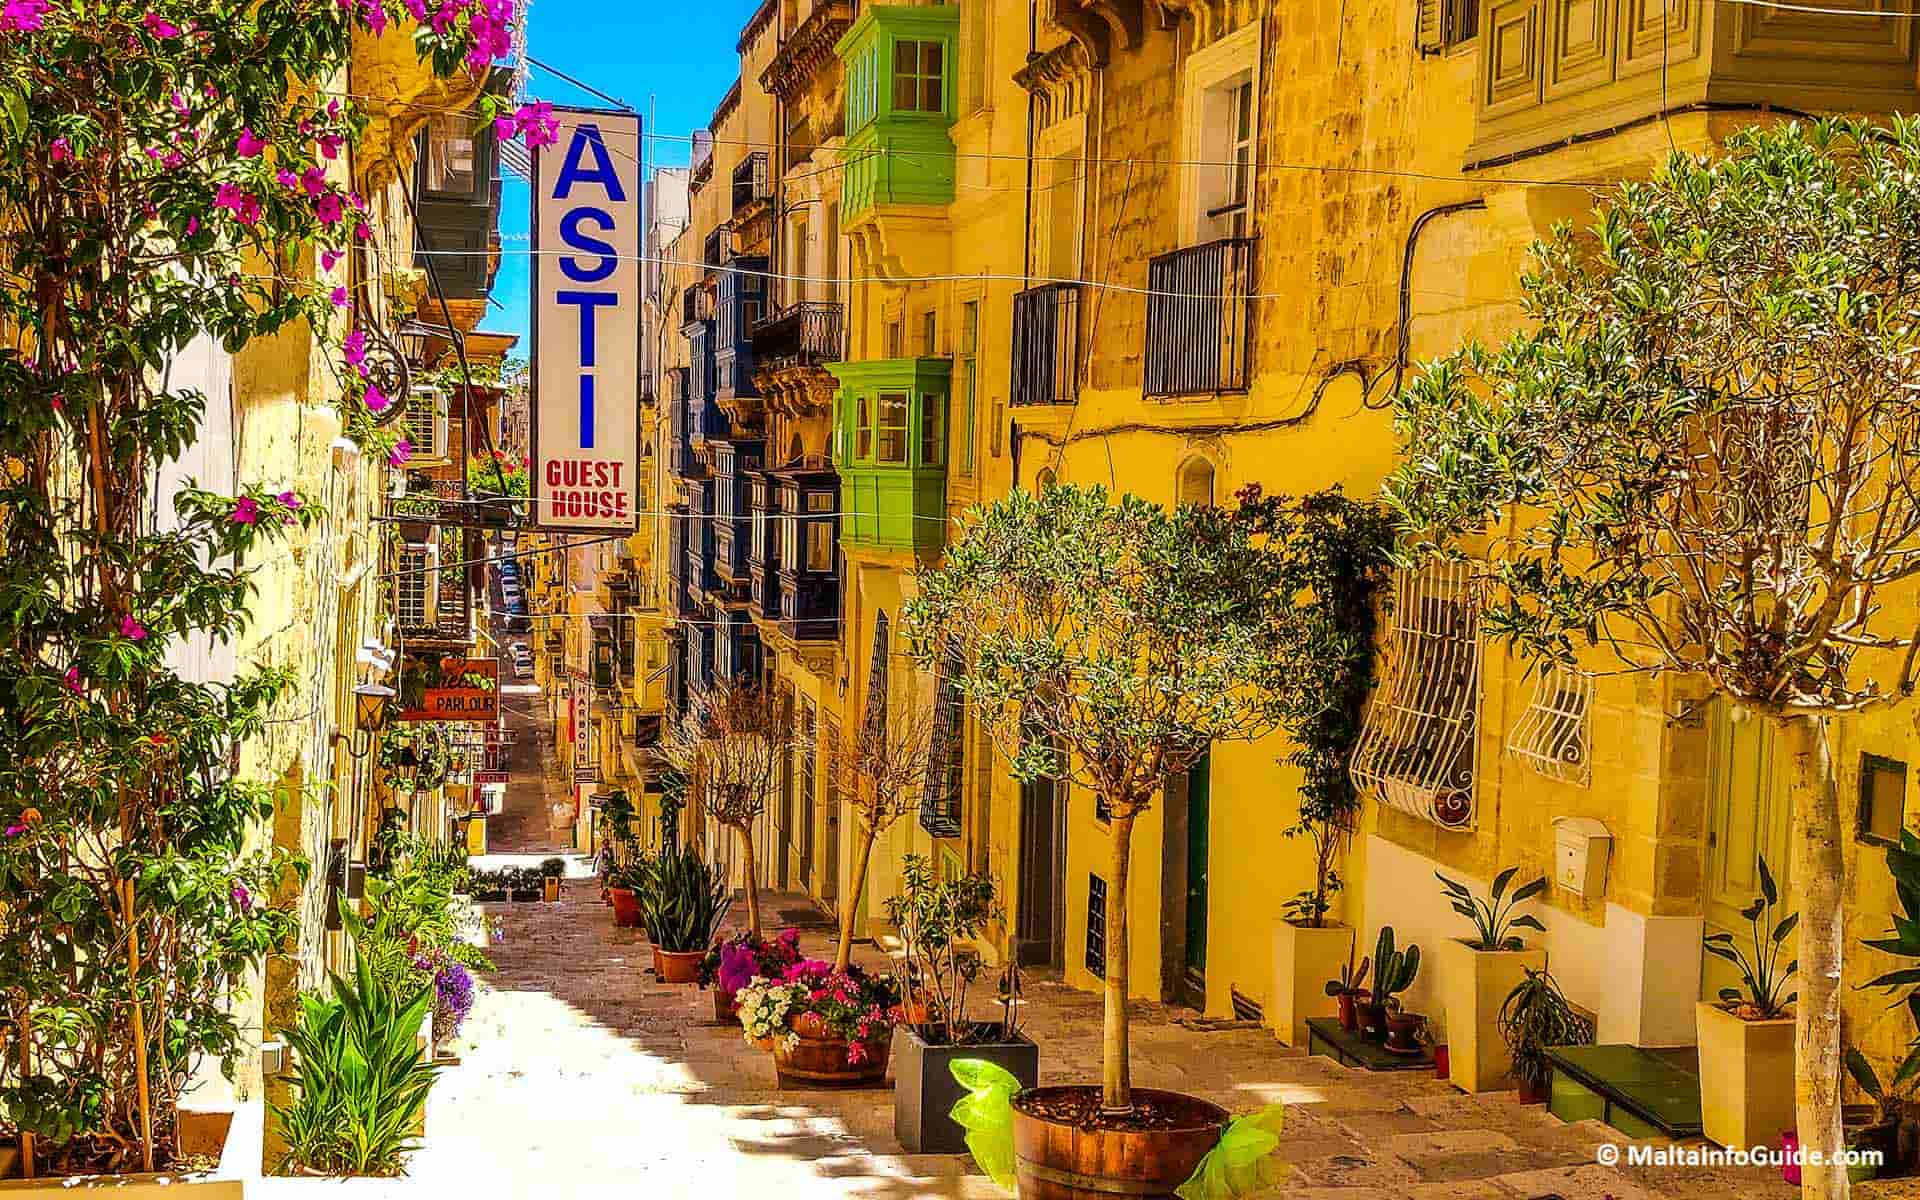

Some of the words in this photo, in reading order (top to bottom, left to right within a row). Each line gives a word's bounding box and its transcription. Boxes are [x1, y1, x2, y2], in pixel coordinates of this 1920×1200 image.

[551, 123, 626, 449] ASTI
[546, 460, 624, 488] GUEST
[551, 491, 627, 518] HOUSE
[436, 696, 496, 713] PARLOUR
[578, 685, 587, 762] HARBOUR
